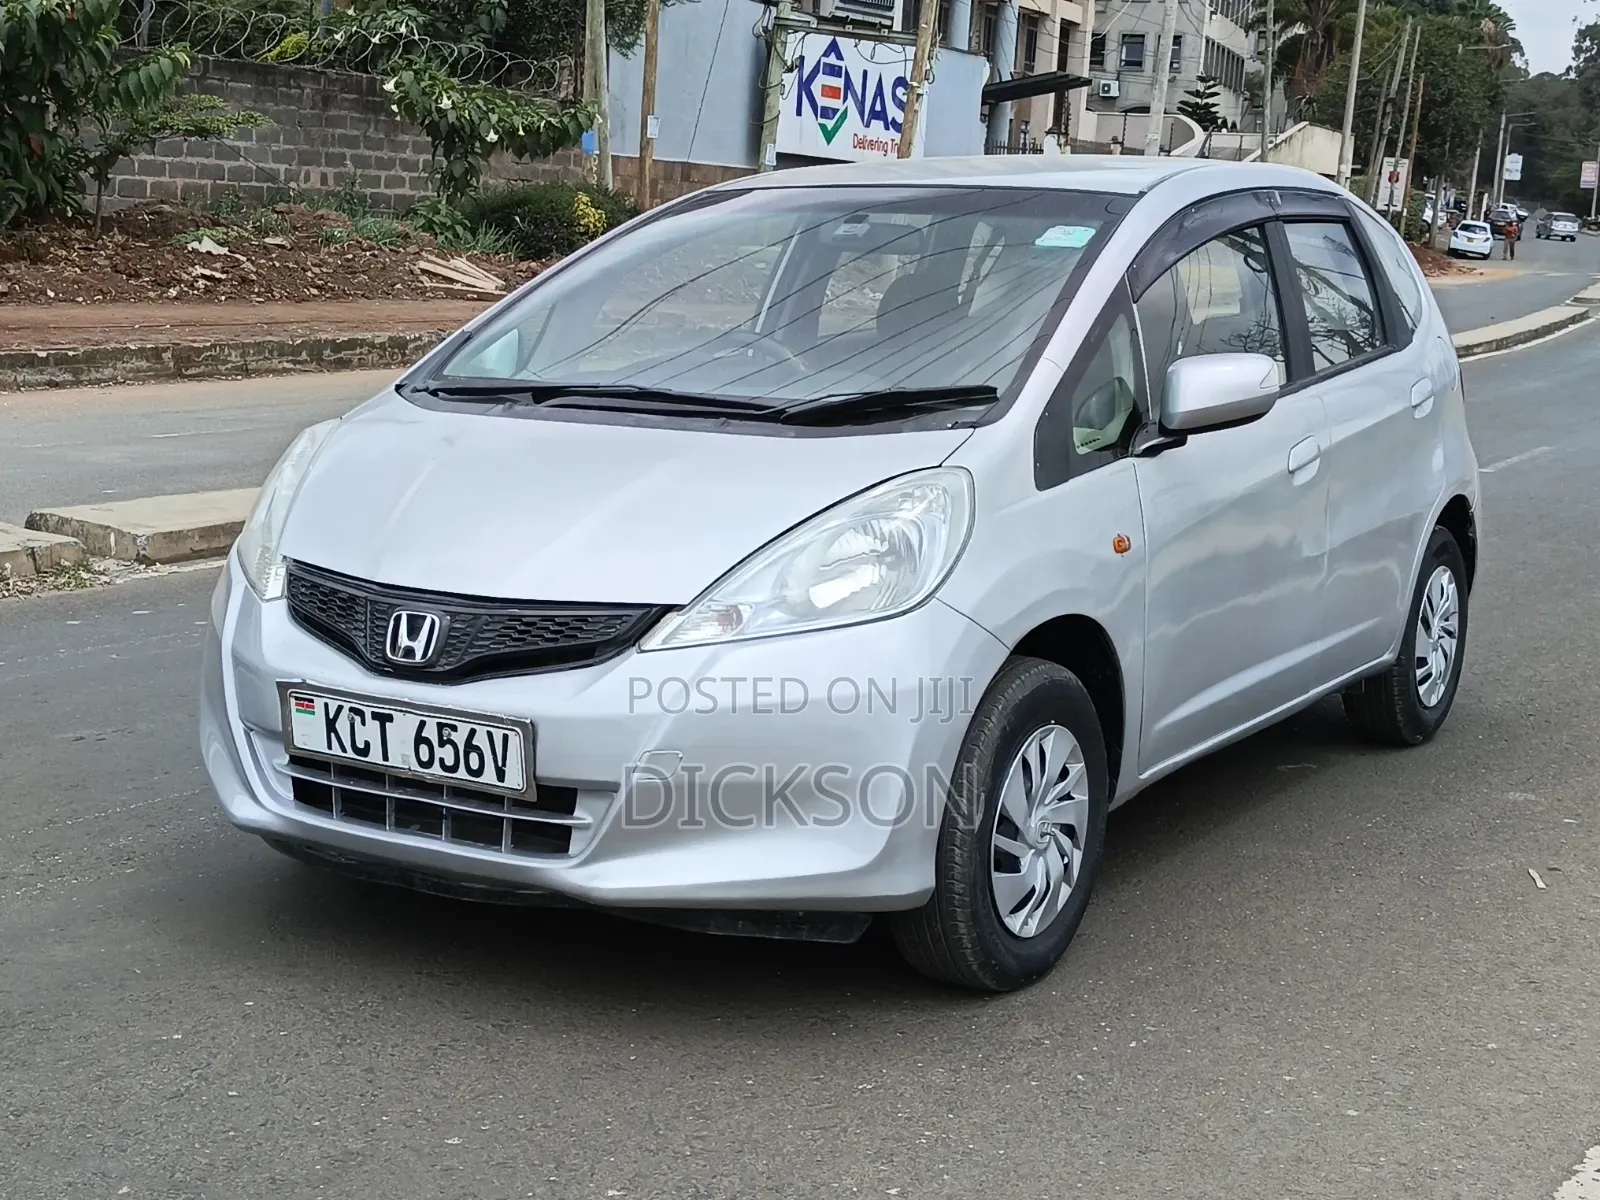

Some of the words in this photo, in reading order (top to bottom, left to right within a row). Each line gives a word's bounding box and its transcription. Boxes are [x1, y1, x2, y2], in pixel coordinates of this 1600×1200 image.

[796, 49, 910, 134] KENAS
[852, 133, 889, 157] Delivering
[323, 701, 394, 762] KCT
[413, 719, 509, 784] 656V
